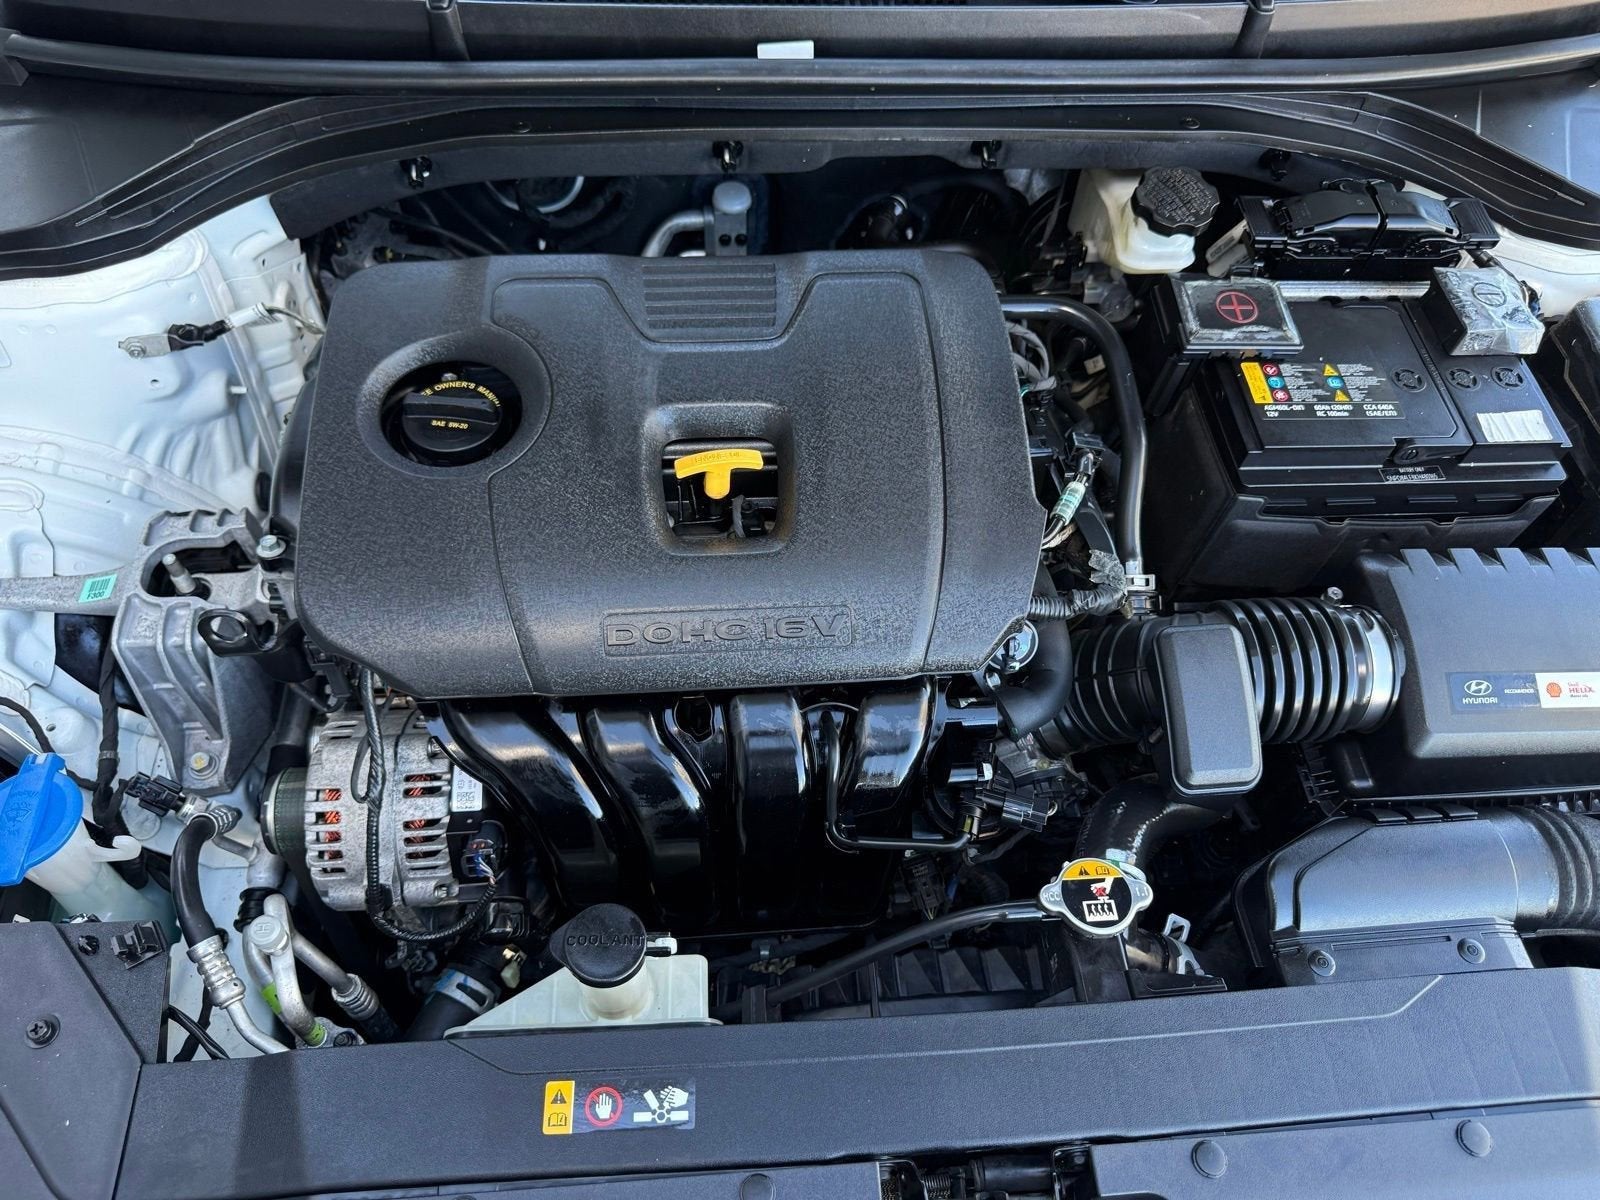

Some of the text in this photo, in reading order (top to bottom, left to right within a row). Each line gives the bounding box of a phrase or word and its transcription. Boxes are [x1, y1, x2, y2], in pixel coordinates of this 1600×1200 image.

[434, 381, 476, 391] OWNER'S
[448, 421, 469, 429] 5W-20
[606, 614, 848, 647] DOHC 16V
[1462, 697, 1498, 705] HYUNDAI
[1042, 892, 1060, 901] HCC
[566, 934, 645, 948] COOLANT
